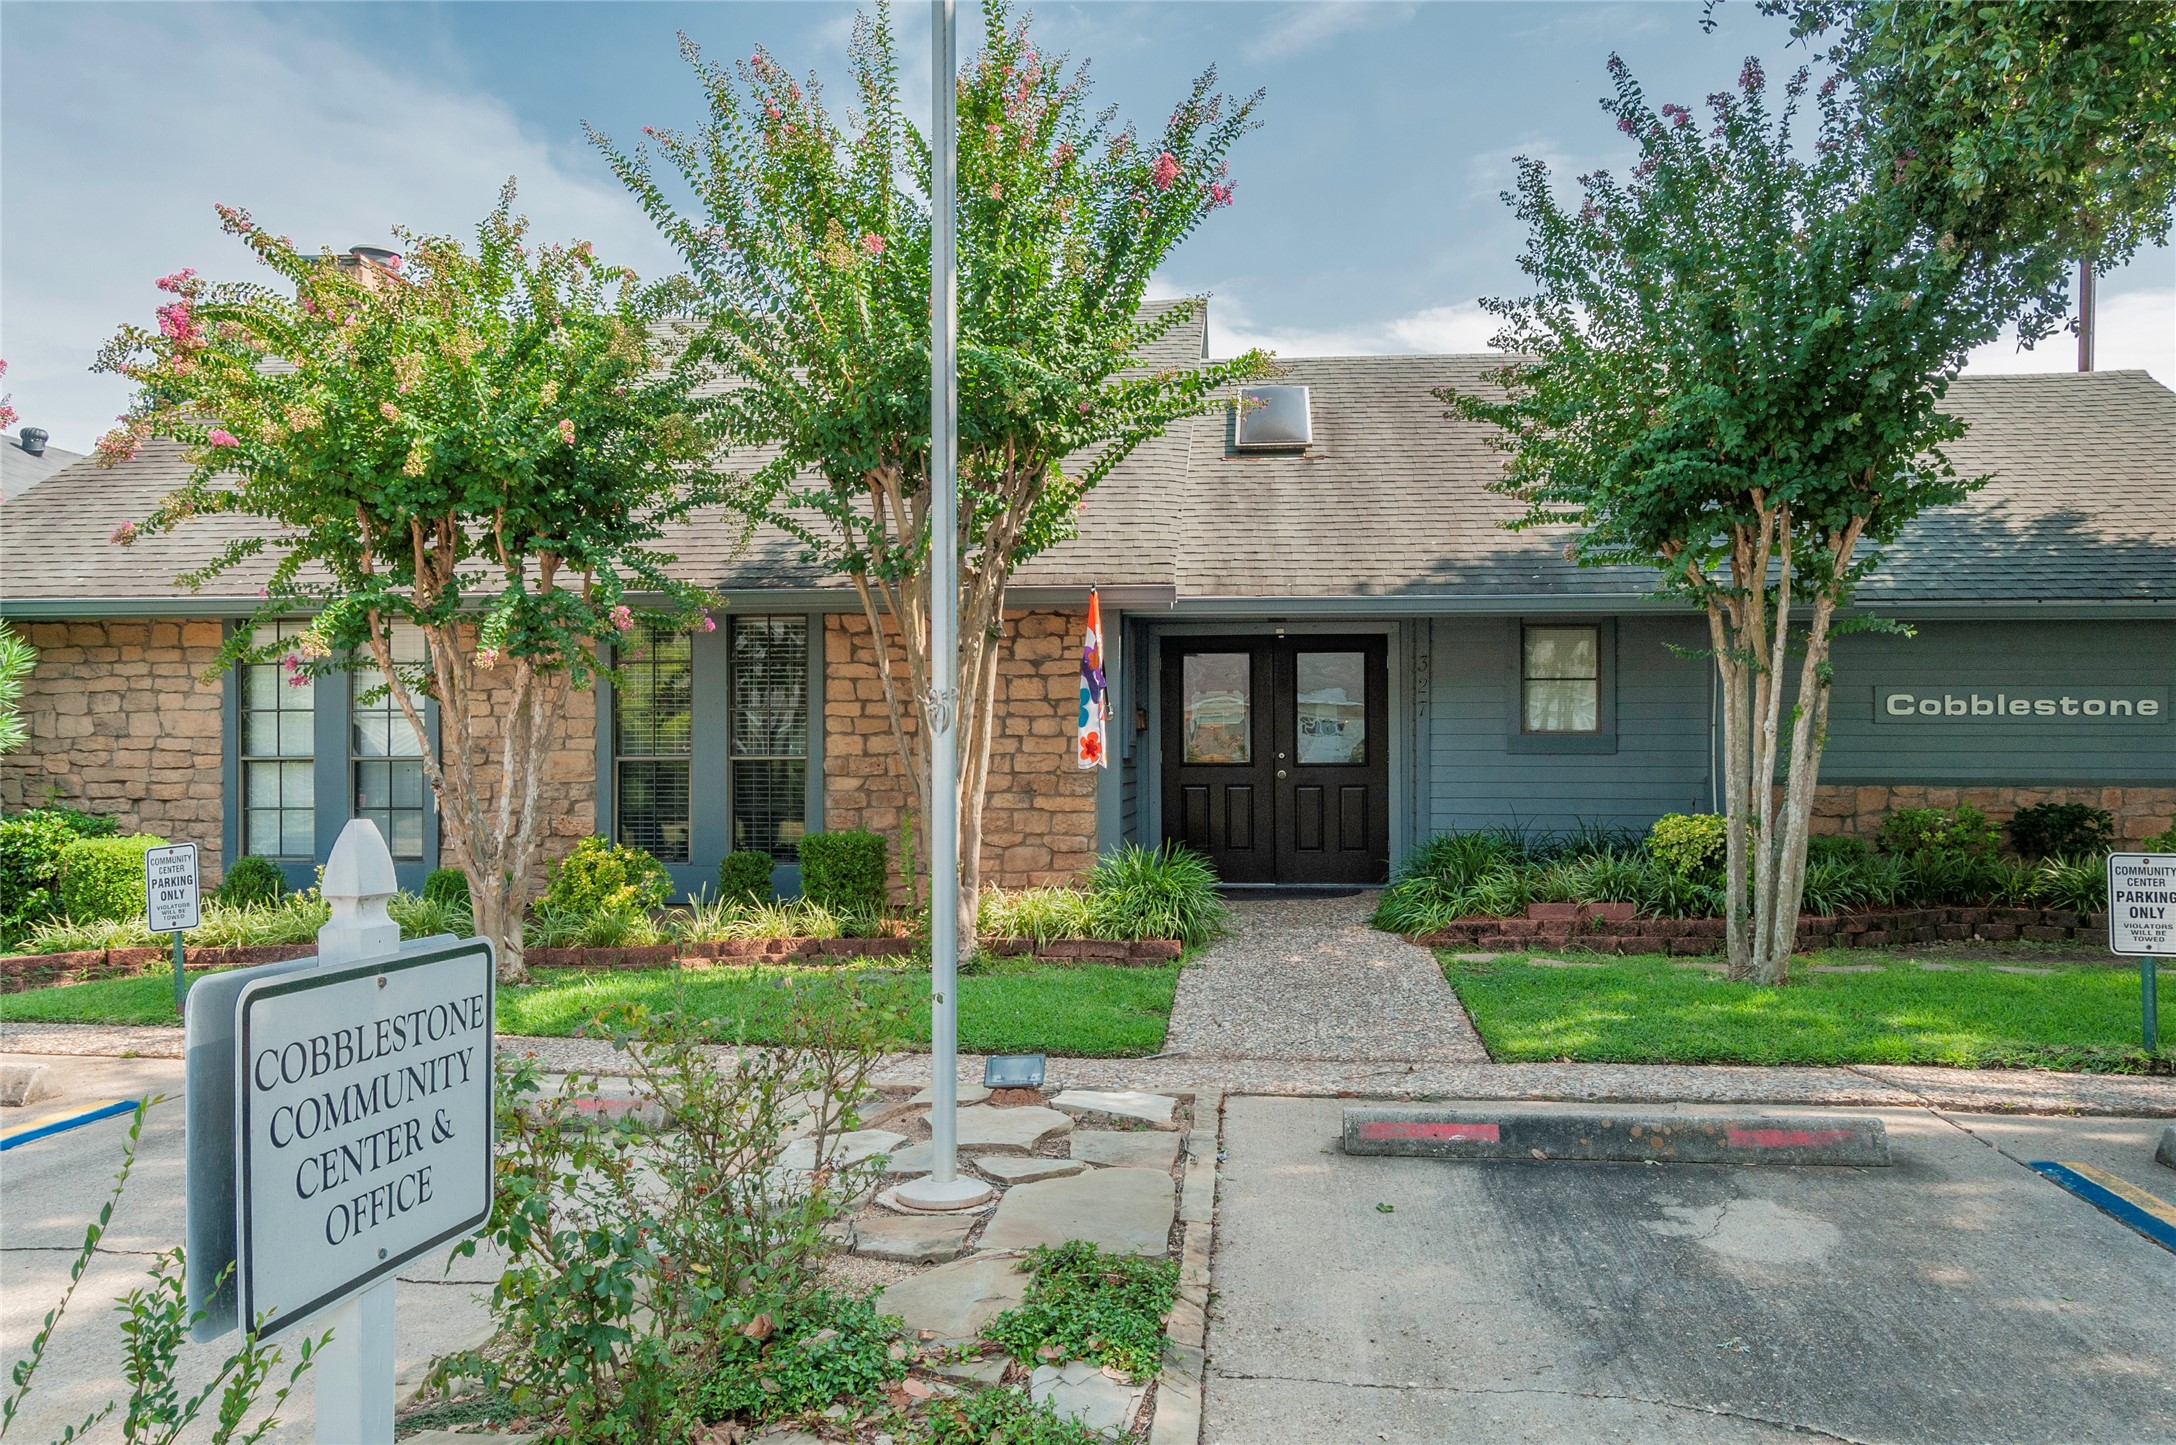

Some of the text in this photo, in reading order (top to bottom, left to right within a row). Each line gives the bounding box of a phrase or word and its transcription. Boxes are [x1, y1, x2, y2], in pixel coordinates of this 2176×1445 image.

[1886, 694, 2159, 716] Cobblestone
[150, 854, 192, 866] COMMUNITY
[158, 865, 185, 875] CENTER
[2114, 866, 2176, 876] COMMUNITY
[151, 875, 193, 889] PARKING
[2127, 877, 2166, 887] CENTER
[160, 889, 185, 901] ONLY
[2116, 890, 2176, 904] PARKING
[156, 902, 191, 911] VIOLATORS
[2129, 906, 2165, 919] ONLY
[254, 994, 485, 1092] COBBLESTONE
[269, 1046, 474, 1149] COMMUNITY
[296, 1108, 456, 1200] CENTER &
[325, 1165, 434, 1247] OFFICE
